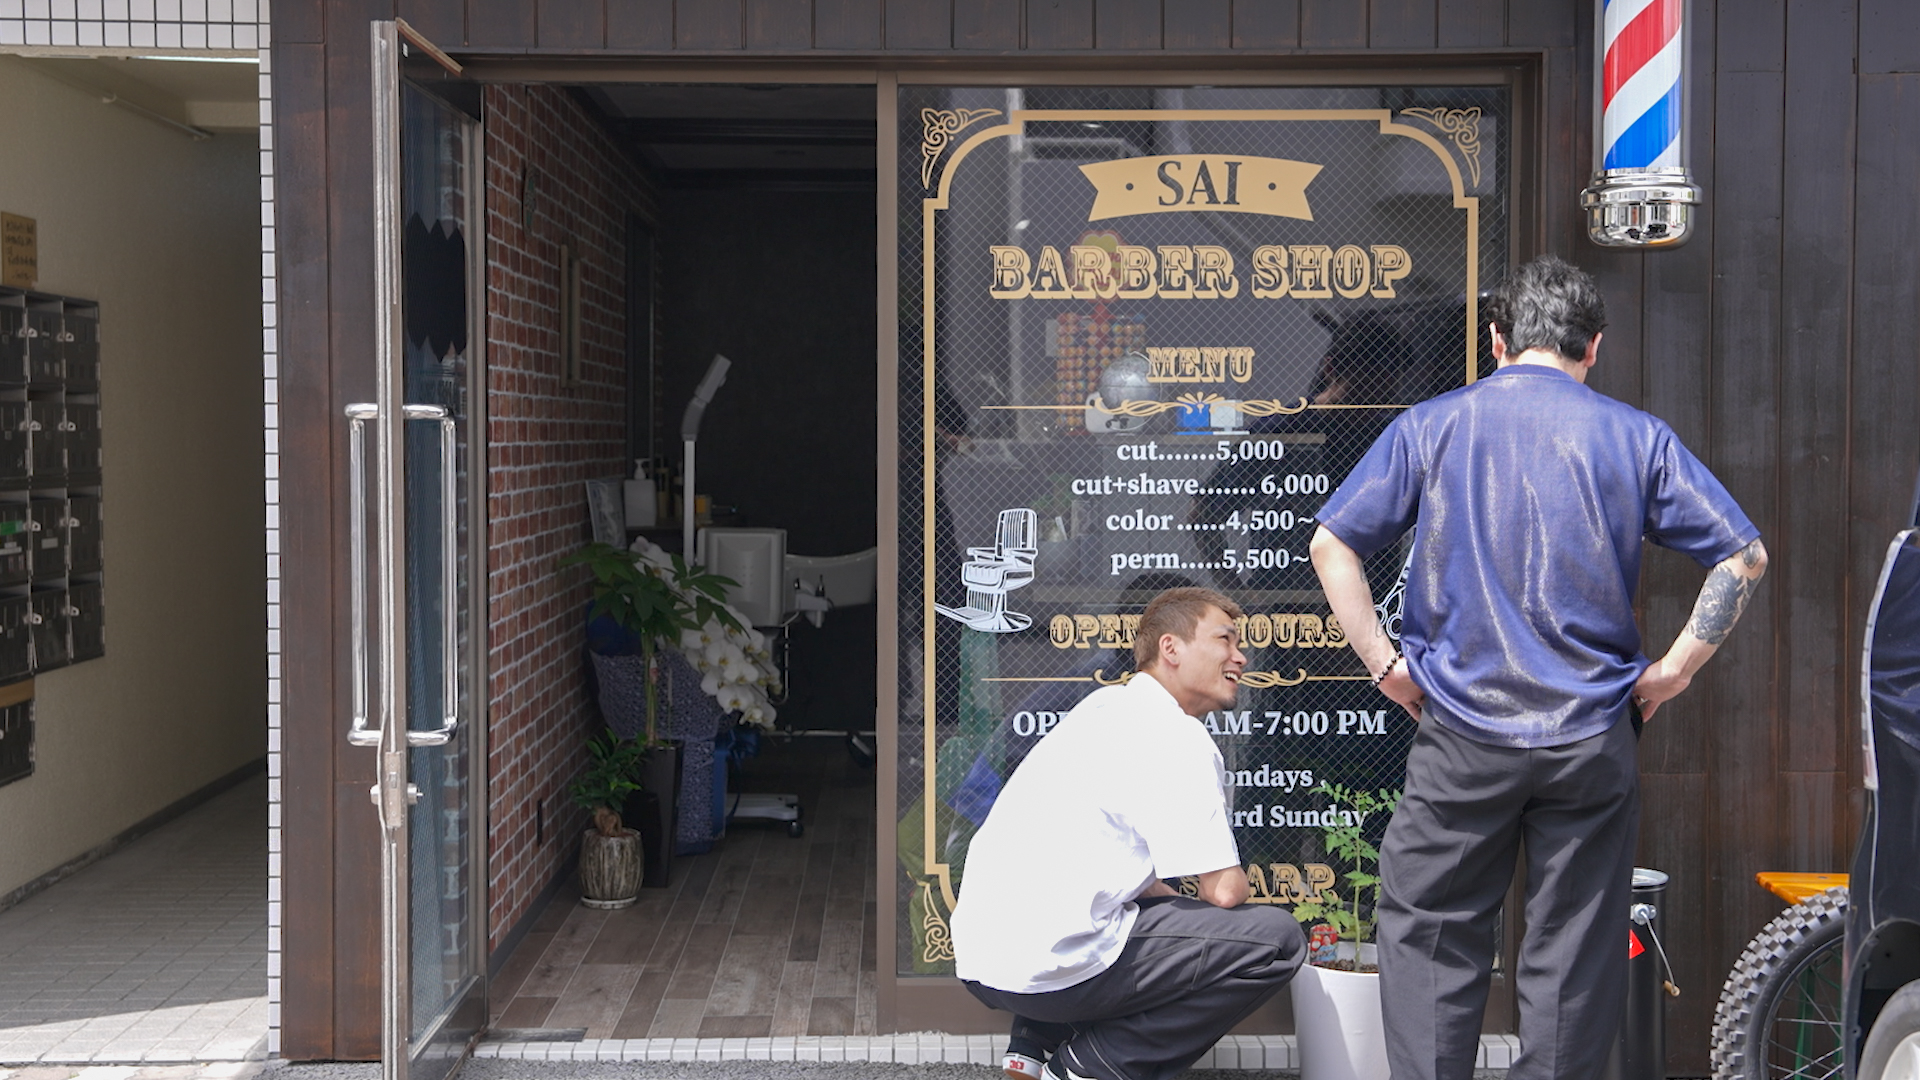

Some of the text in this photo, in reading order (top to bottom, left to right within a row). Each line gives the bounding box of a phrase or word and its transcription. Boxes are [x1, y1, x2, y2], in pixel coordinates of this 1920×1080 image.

[1158, 160, 1242, 206] SAI
[989, 245, 1239, 299] BARBER
[1251, 244, 1412, 299] SHOP
[1146, 347, 1255, 382] MENU
[1261, 473, 1329, 499] 6,000
[1106, 508, 1174, 531] color
[1336, 710, 1387, 735] PM
[1222, 763, 1314, 793] ondays
